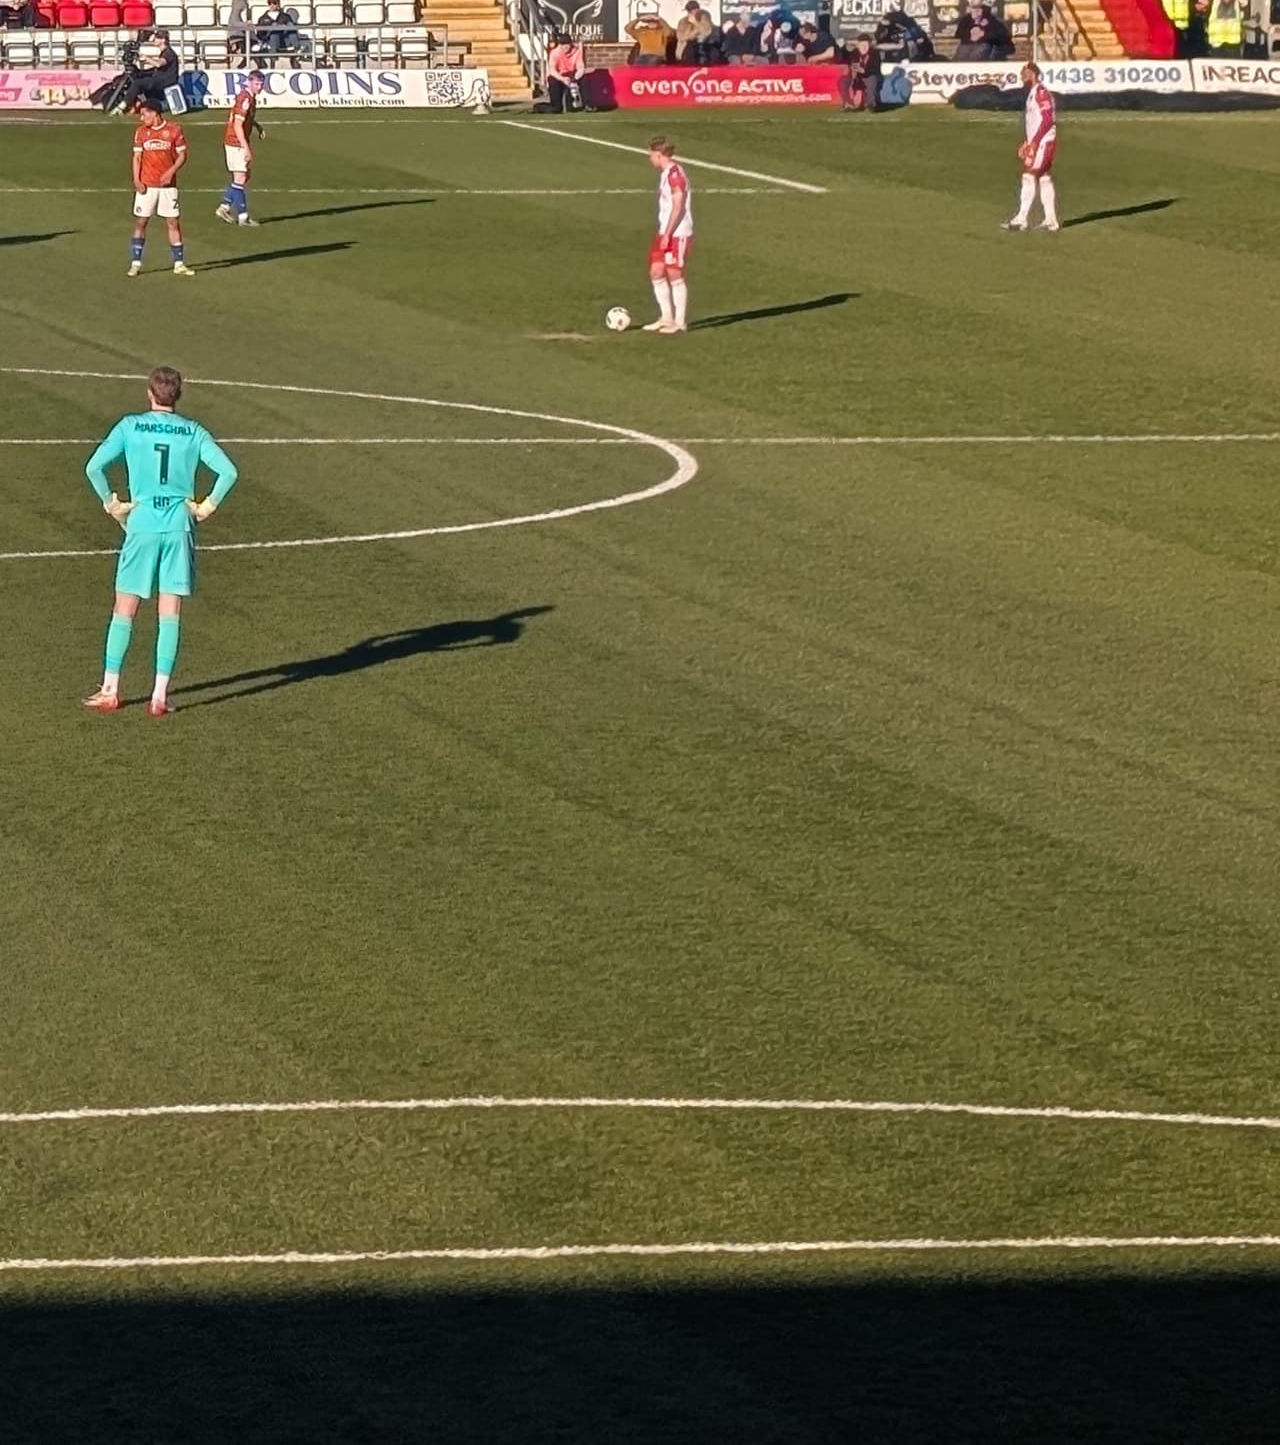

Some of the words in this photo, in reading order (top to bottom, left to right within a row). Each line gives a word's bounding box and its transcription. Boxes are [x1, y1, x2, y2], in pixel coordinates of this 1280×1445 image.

[542, 24, 604, 35] NGELIQUE
[189, 71, 212, 95] K
[264, 70, 403, 95] COINS
[631, 70, 733, 97] everyone
[737, 77, 804, 93] ACTIVE
[1103, 66, 1182, 83] 310200
[297, 96, 406, 106] www.kbcoins.com
[153, 442, 171, 485] 1
